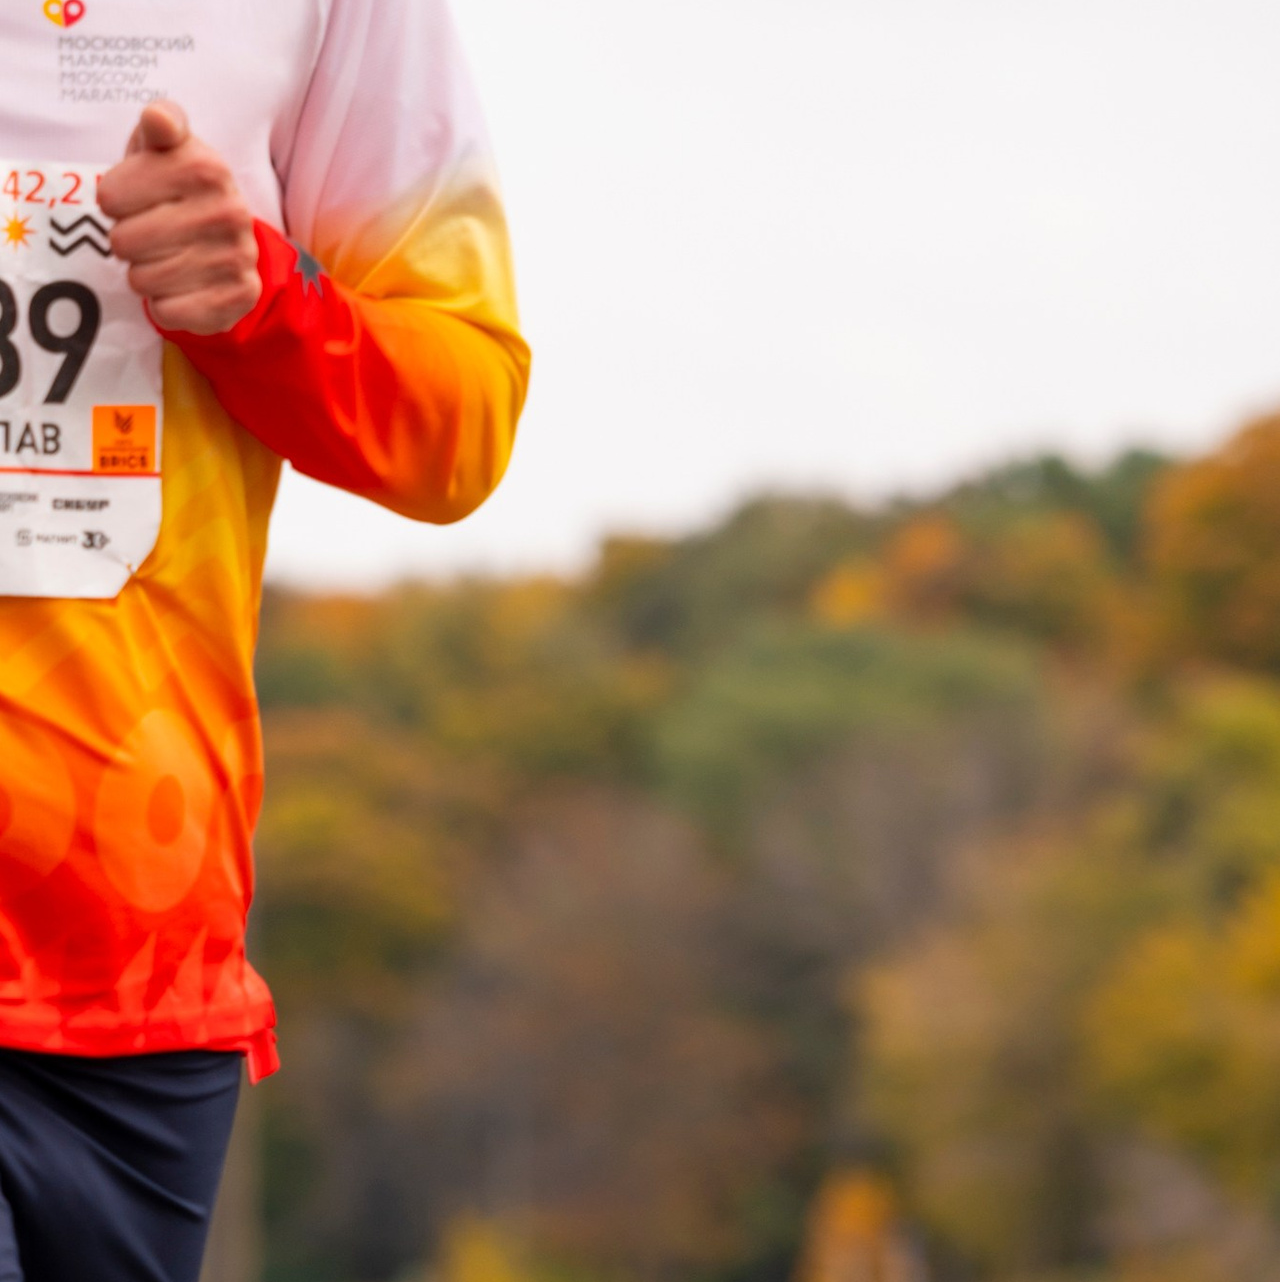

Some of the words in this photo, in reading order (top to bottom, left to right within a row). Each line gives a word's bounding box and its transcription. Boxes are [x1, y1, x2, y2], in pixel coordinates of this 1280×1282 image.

[58, 34, 195, 52] МОСКОВСКИЙ
[58, 54, 158, 68] МАРАФОН
[60, 71, 148, 85] MOSCOW
[3, 170, 83, 209] 42,2
